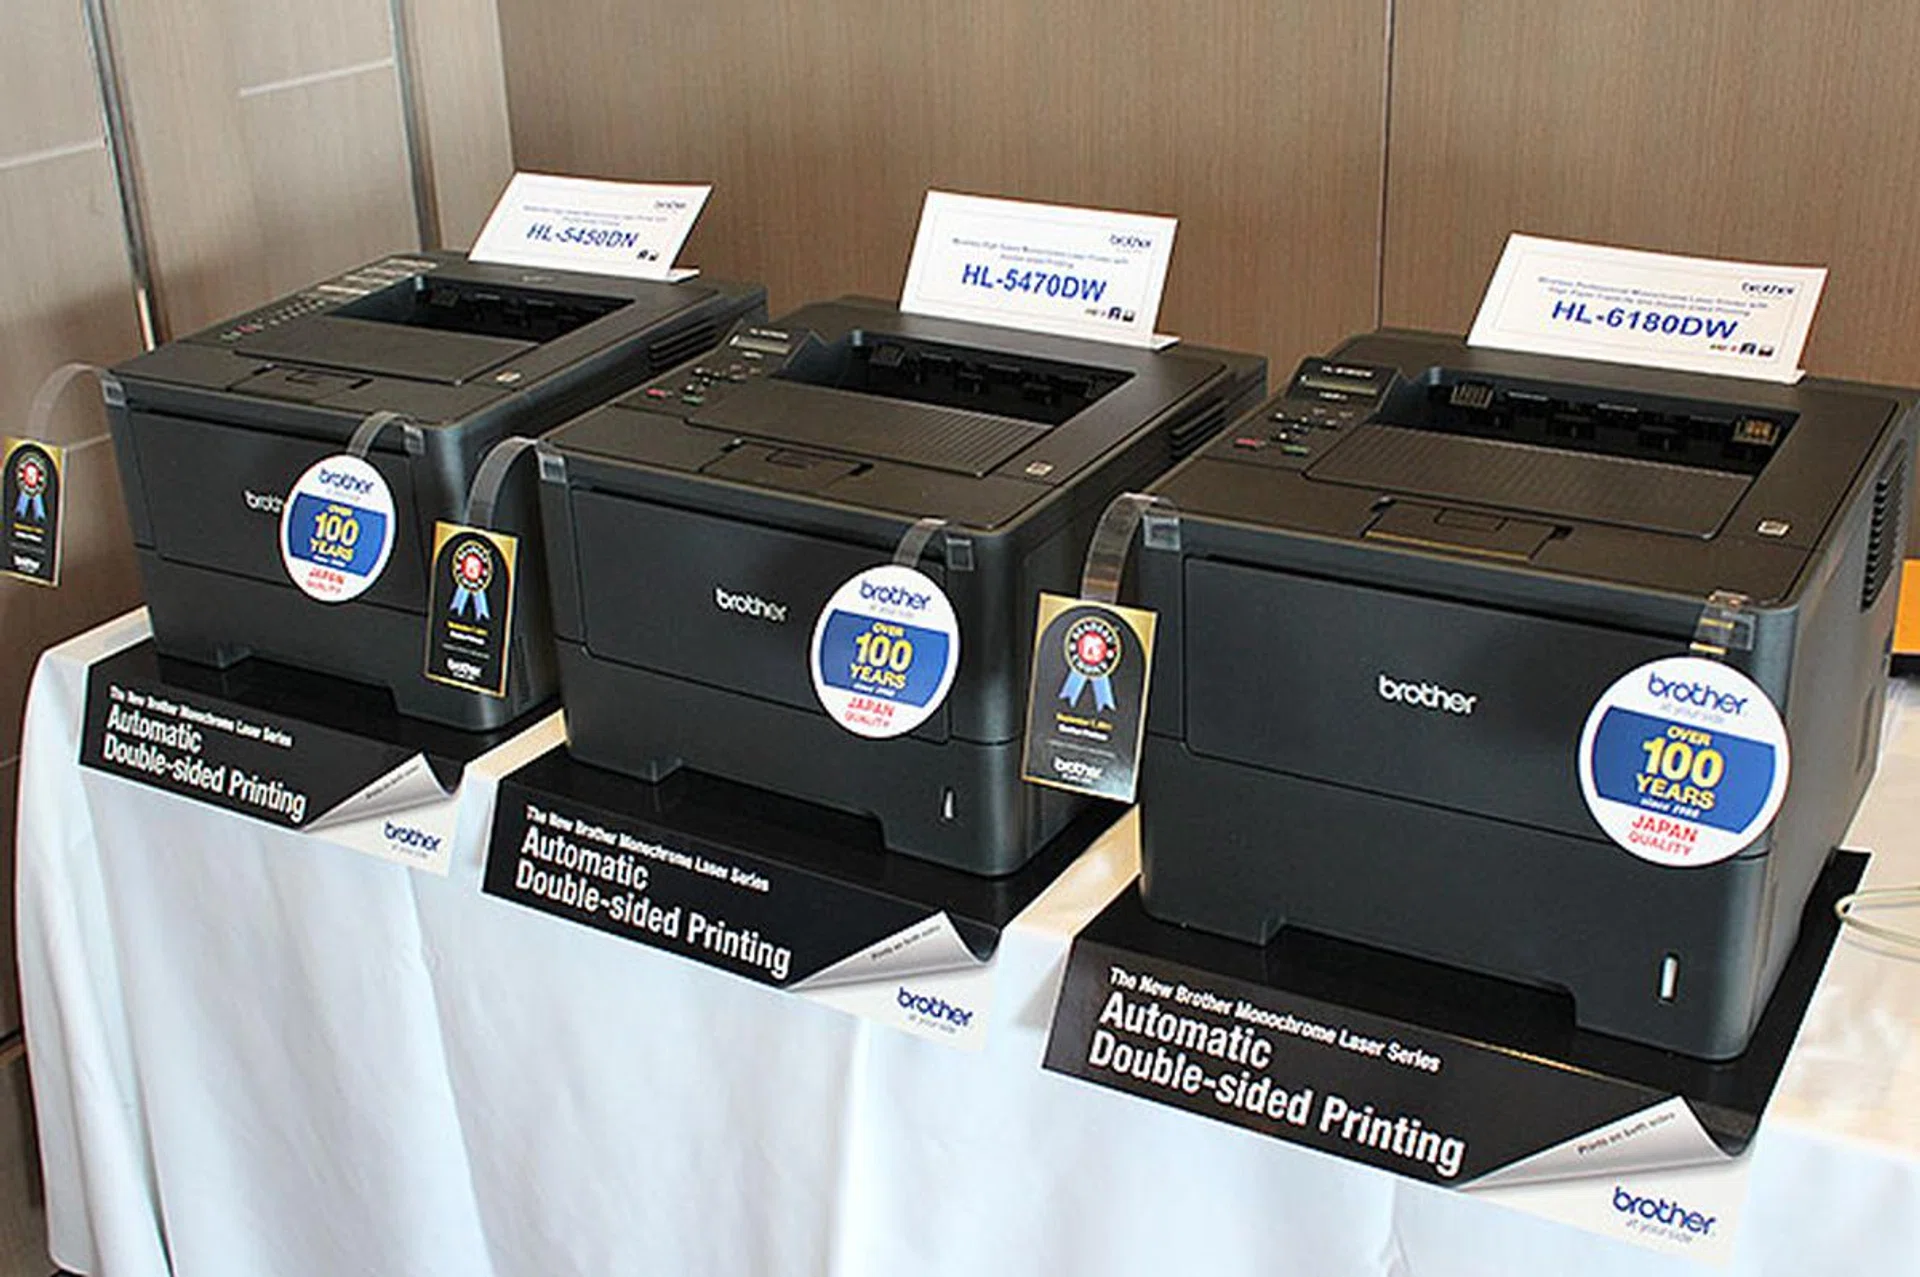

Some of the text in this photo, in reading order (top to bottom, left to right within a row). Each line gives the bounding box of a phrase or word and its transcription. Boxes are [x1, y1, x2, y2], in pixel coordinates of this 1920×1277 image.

[527, 222, 640, 248] HL-5450DN
[961, 263, 1107, 302] HL-5470DW
[1551, 299, 1738, 339] HL-6180DW
[315, 512, 360, 546] 100
[715, 588, 788, 622] brother
[859, 579, 933, 611] brother
[872, 622, 905, 637] OVER
[855, 632, 914, 673] 100
[850, 662, 907, 690] YEARS
[1378, 673, 1478, 715] brother
[1647, 672, 1749, 715] brother
[847, 696, 895, 718] JAPAN
[107, 703, 203, 754] Automatic
[1667, 725, 1713, 746] OVER
[102, 732, 225, 793] Double-sided
[228, 768, 308, 823] Printing
[1643, 736, 1726, 789] 100
[1636, 772, 1716, 810] YEARS
[384, 821, 442, 851] brother
[526, 804, 770, 893] The New Brother Monochrome Laser Series
[1628, 831, 1693, 856] QUALITY
[1631, 814, 1699, 843] JAPAN
[520, 824, 651, 891] Automatic
[514, 859, 791, 981] Double-sided Printing
[896, 986, 974, 1027] brother
[1110, 965, 1442, 1074] The New Brother Monochrome Laser Series
[1099, 989, 1274, 1070] Automatic
[1088, 1028, 1467, 1180] Double-sided Printing
[1612, 1185, 1717, 1236] brother
